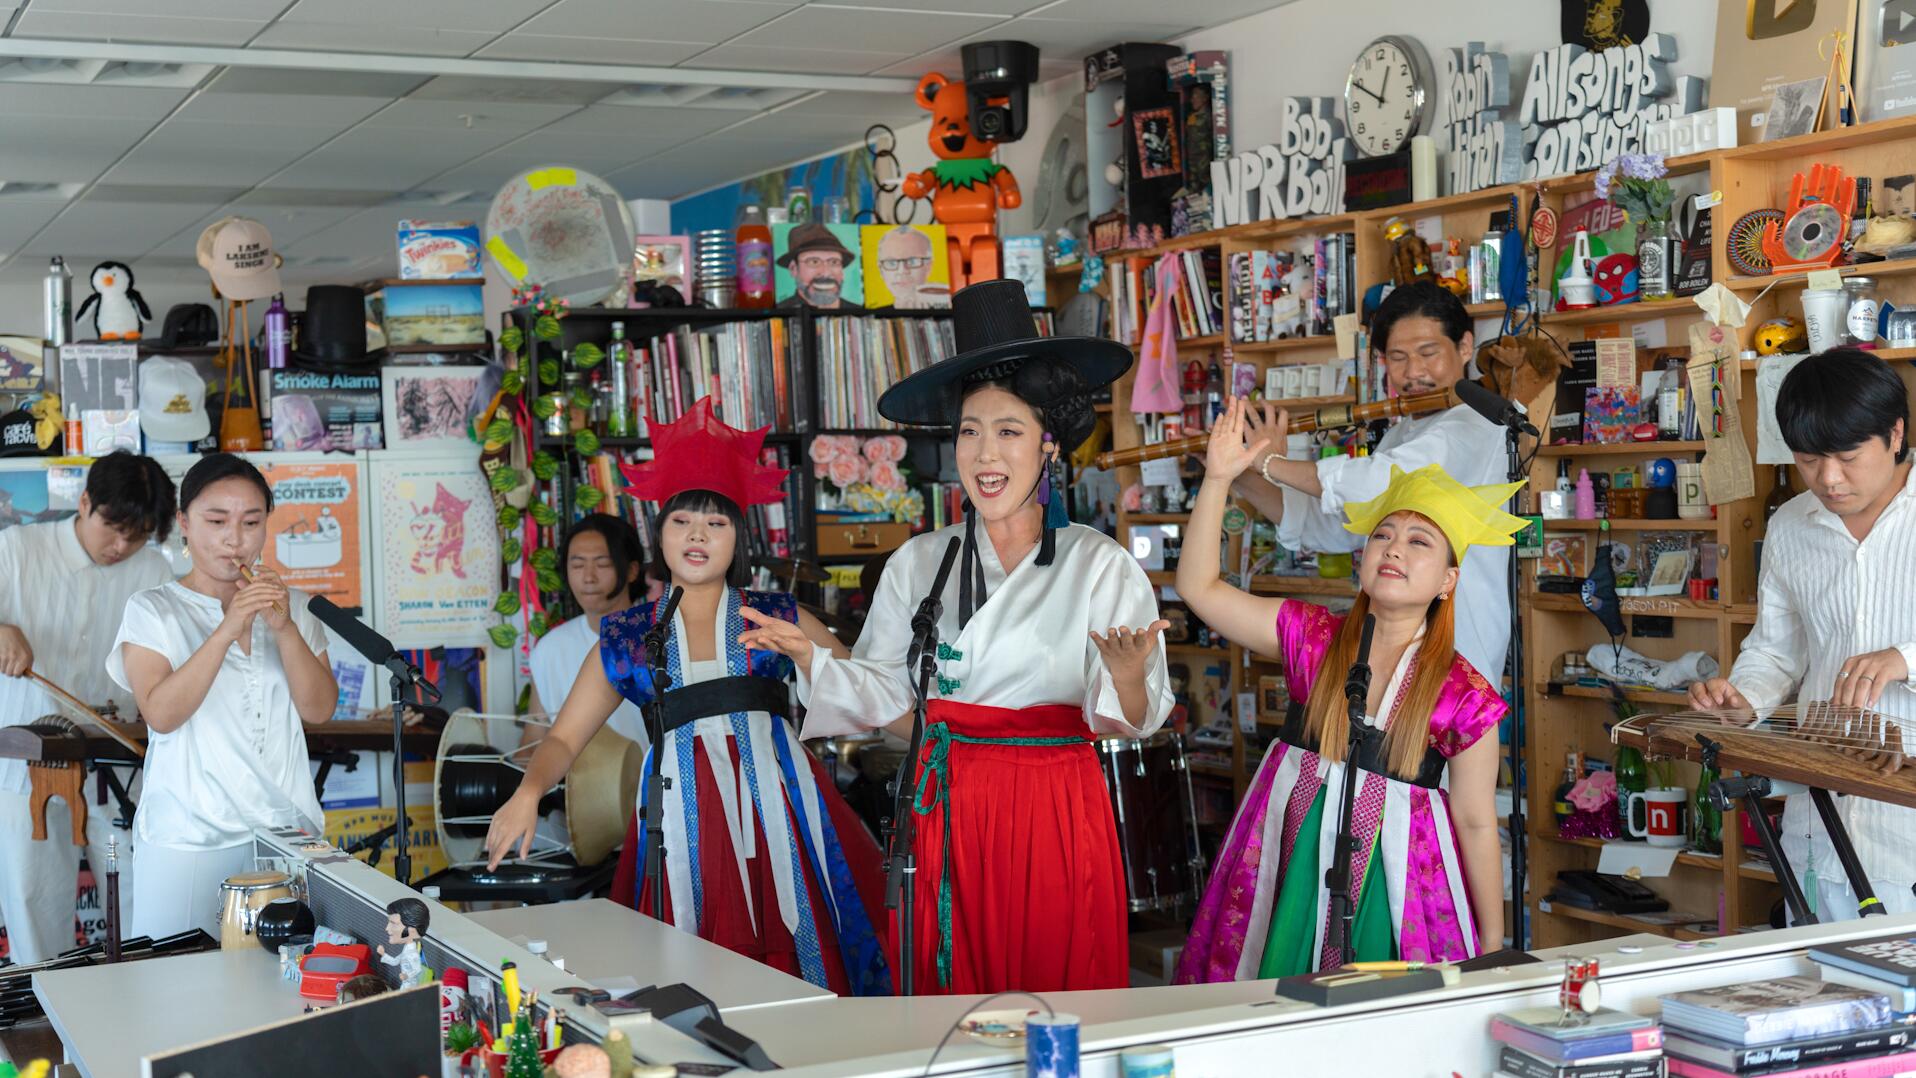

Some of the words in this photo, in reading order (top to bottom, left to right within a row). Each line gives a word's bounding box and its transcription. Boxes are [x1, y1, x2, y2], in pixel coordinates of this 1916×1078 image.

[1281, 96, 1333, 161] Bob
[1210, 144, 1287, 228] NPR
[245, 243, 260, 252] AM
[405, 240, 457, 264] Twinkies
[274, 372, 329, 389] Smoke
[331, 374, 379, 389] Alarm
[273, 487, 346, 500] CONTEST
[1686, 483, 1699, 503] p
[457, 599, 488, 608] ETTEN
[1659, 600, 1681, 613] PIT
